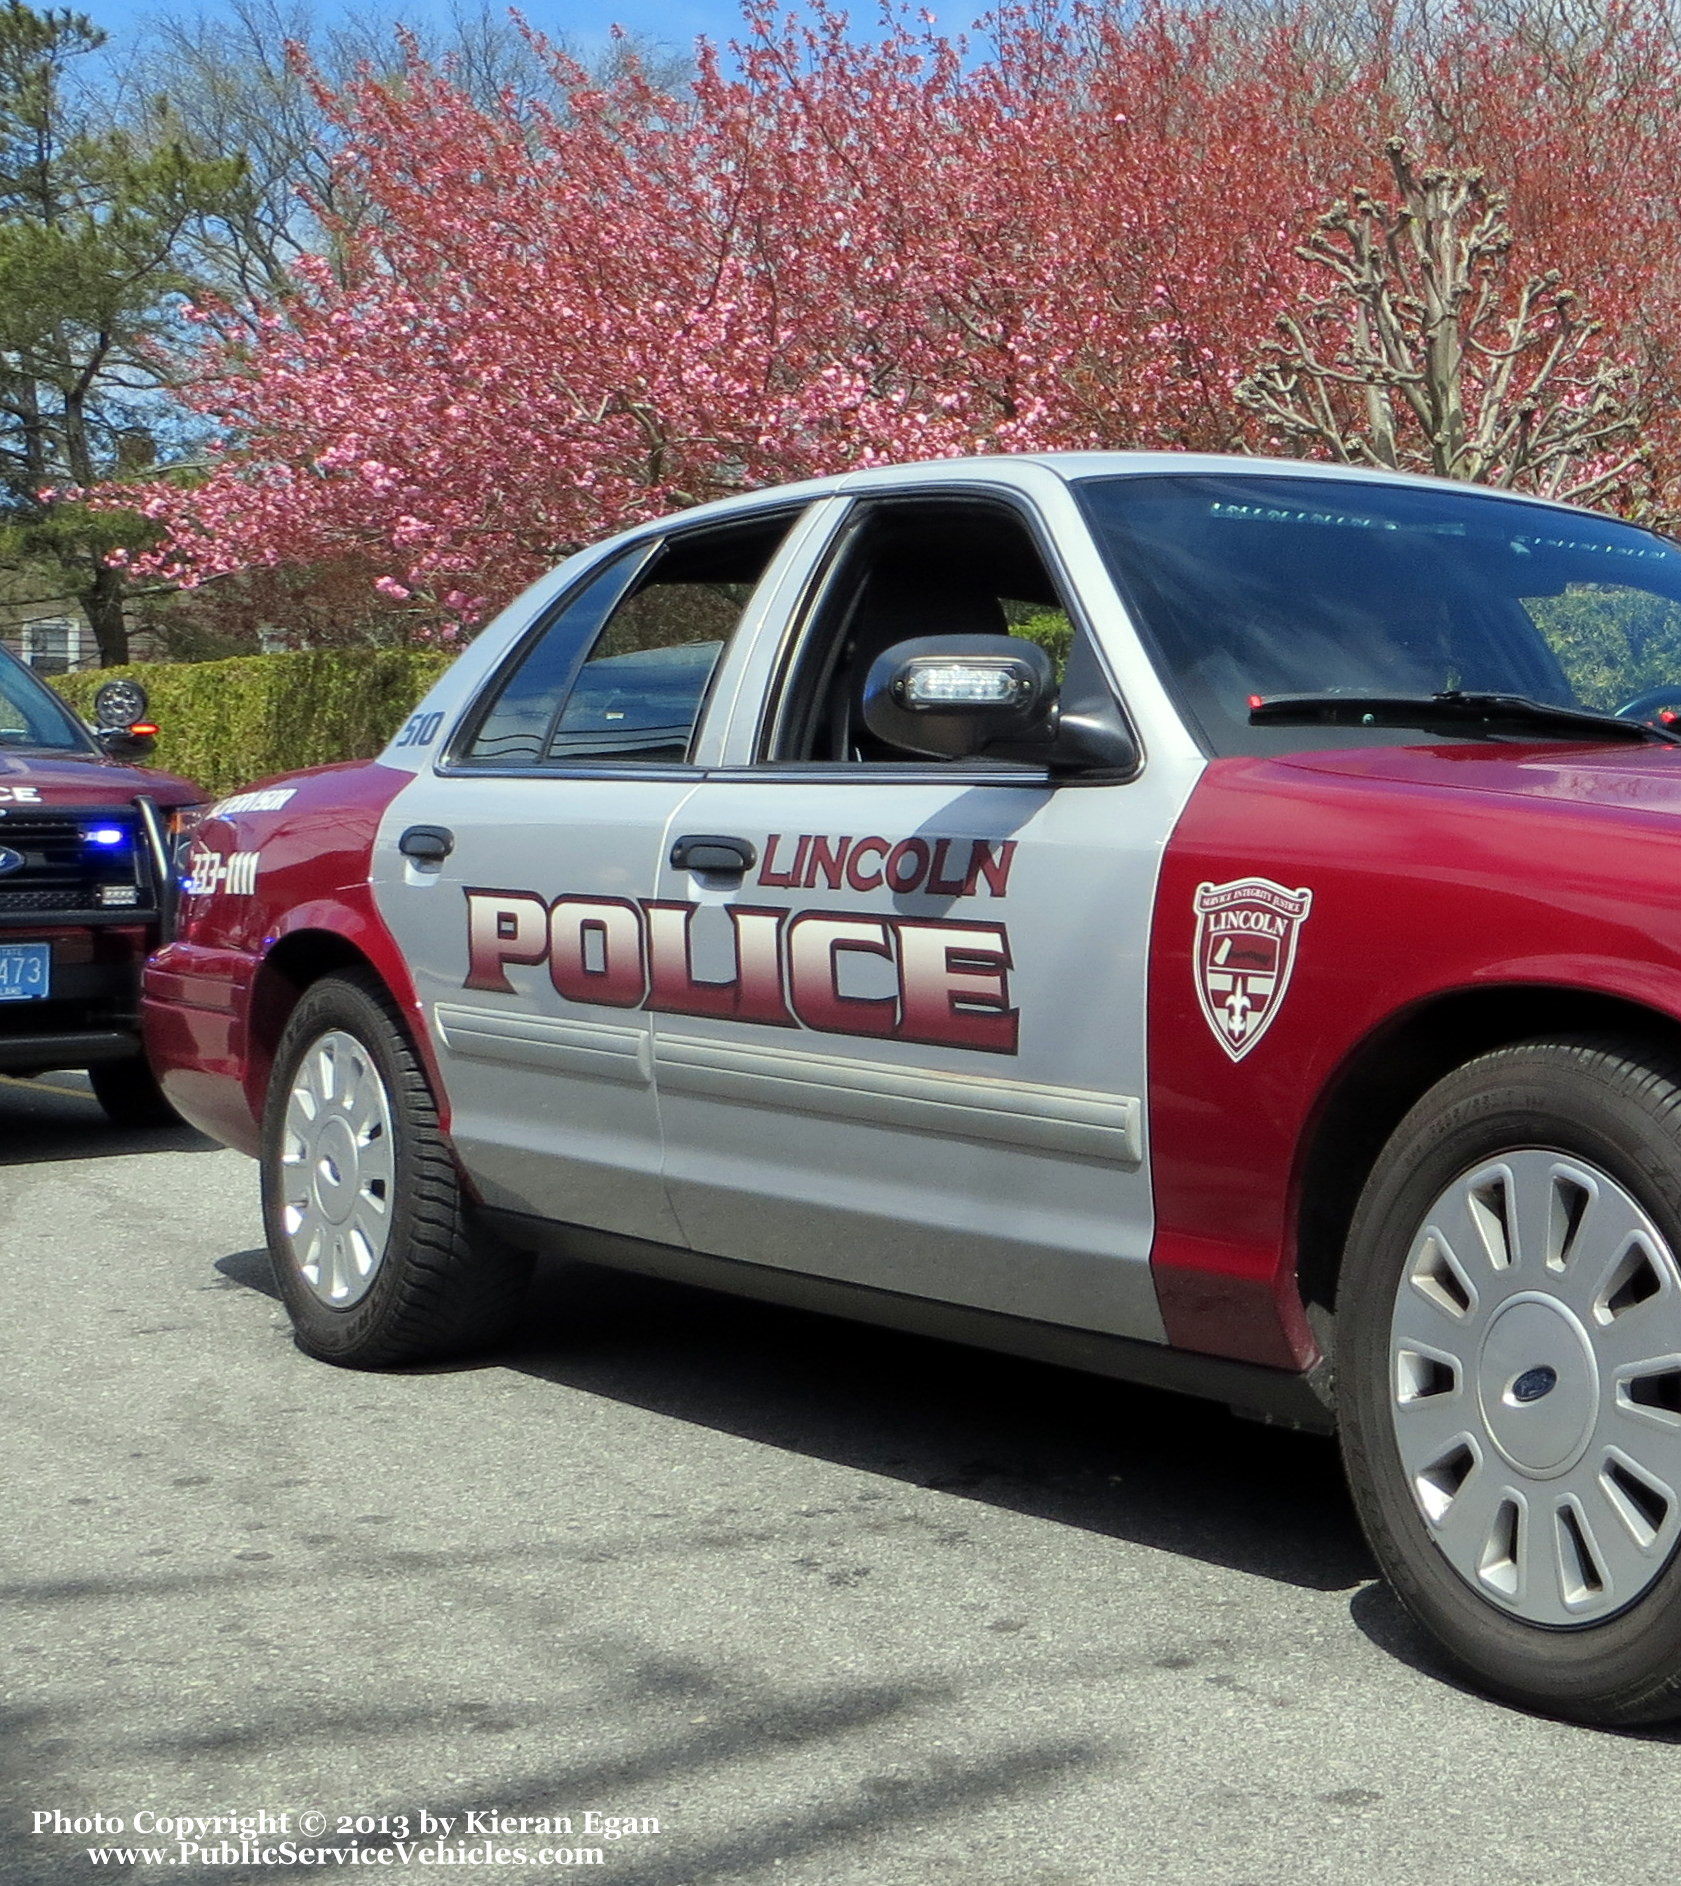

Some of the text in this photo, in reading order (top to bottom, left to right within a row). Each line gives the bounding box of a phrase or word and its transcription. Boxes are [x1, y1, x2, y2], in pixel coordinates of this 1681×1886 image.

[396, 712, 444, 747] 510
[188, 851, 261, 895] 333-1111
[758, 834, 1018, 898] LINCOLN
[1203, 889, 1300, 912] SERVICE INTEGRITY JUSTICE
[1208, 911, 1288, 936] LINCOLN
[462, 886, 1020, 1056] POLICE
